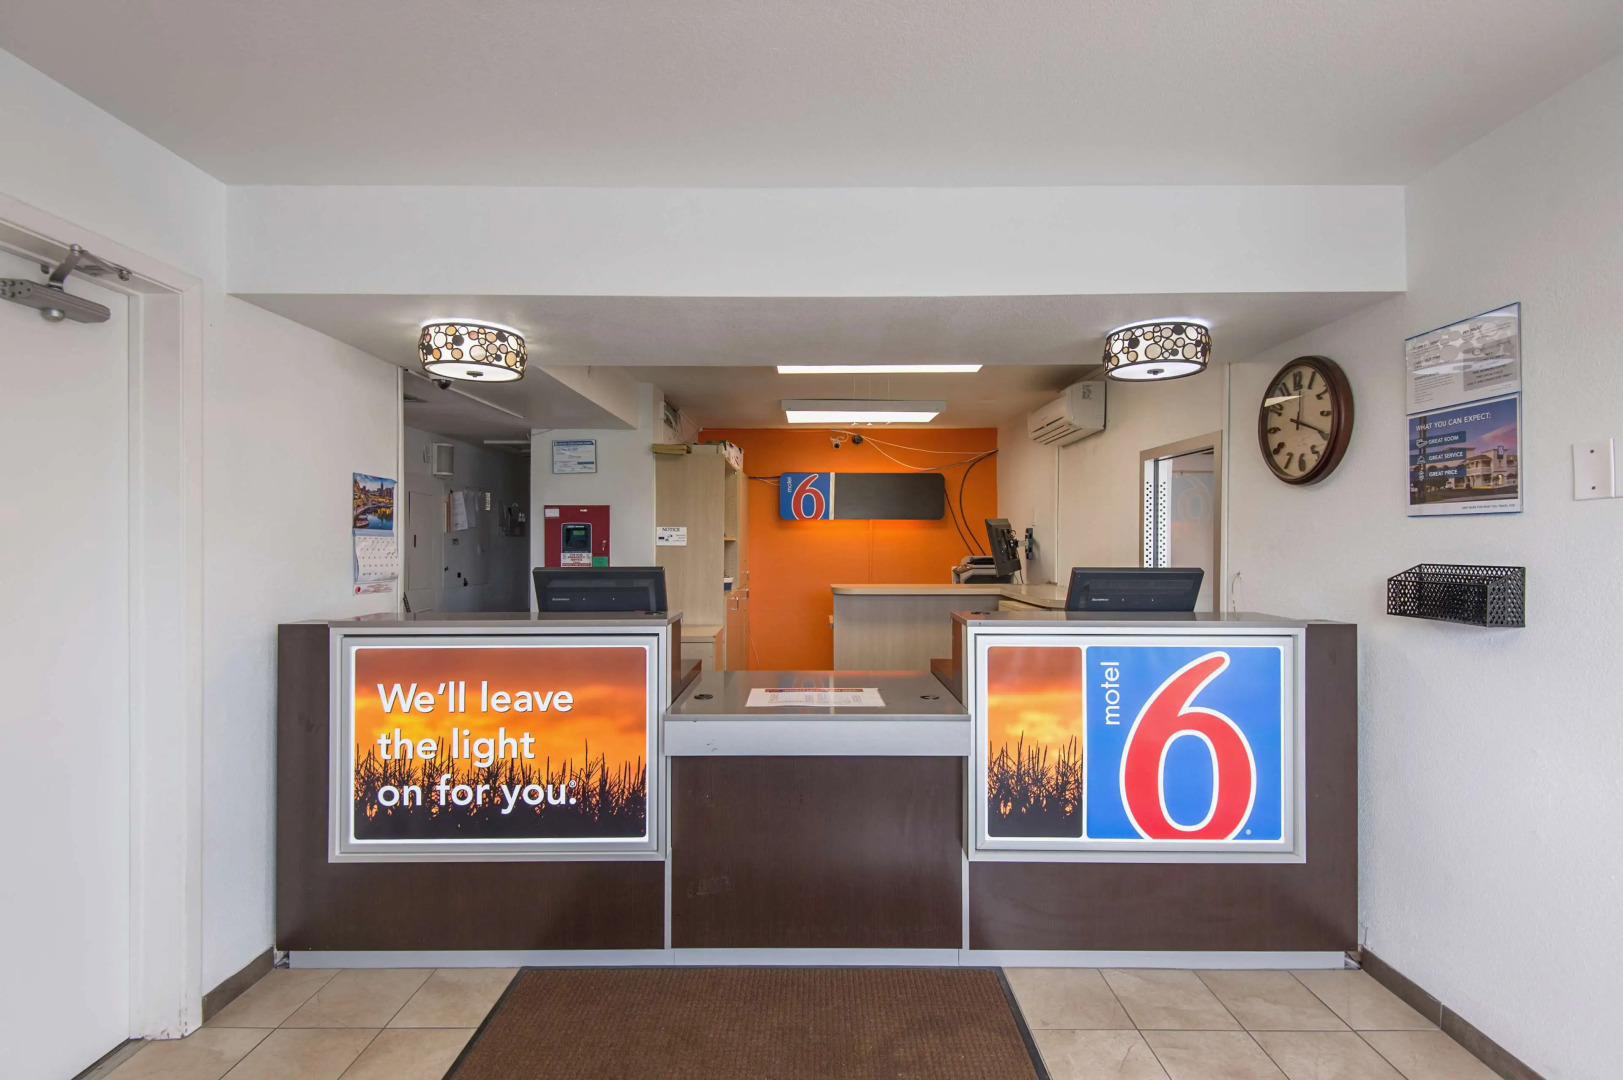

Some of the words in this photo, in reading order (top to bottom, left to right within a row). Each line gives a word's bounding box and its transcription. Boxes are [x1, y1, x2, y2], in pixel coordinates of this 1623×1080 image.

[1416, 422, 1432, 431] WHAT
[1434, 420, 1446, 428] YOU
[1448, 417, 1462, 426] CAN
[1464, 412, 1492, 423] EXPECT:
[1444, 451, 1463, 459] SERVICE
[791, 473, 826, 520] 6
[377, 681, 465, 713] We'll
[481, 681, 574, 713] leave
[1100, 661, 1120, 725] motel
[377, 728, 437, 760] the
[452, 727, 536, 768] light
[1119, 651, 1257, 840] 6
[377, 784, 422, 807] on
[436, 774, 490, 806] for
